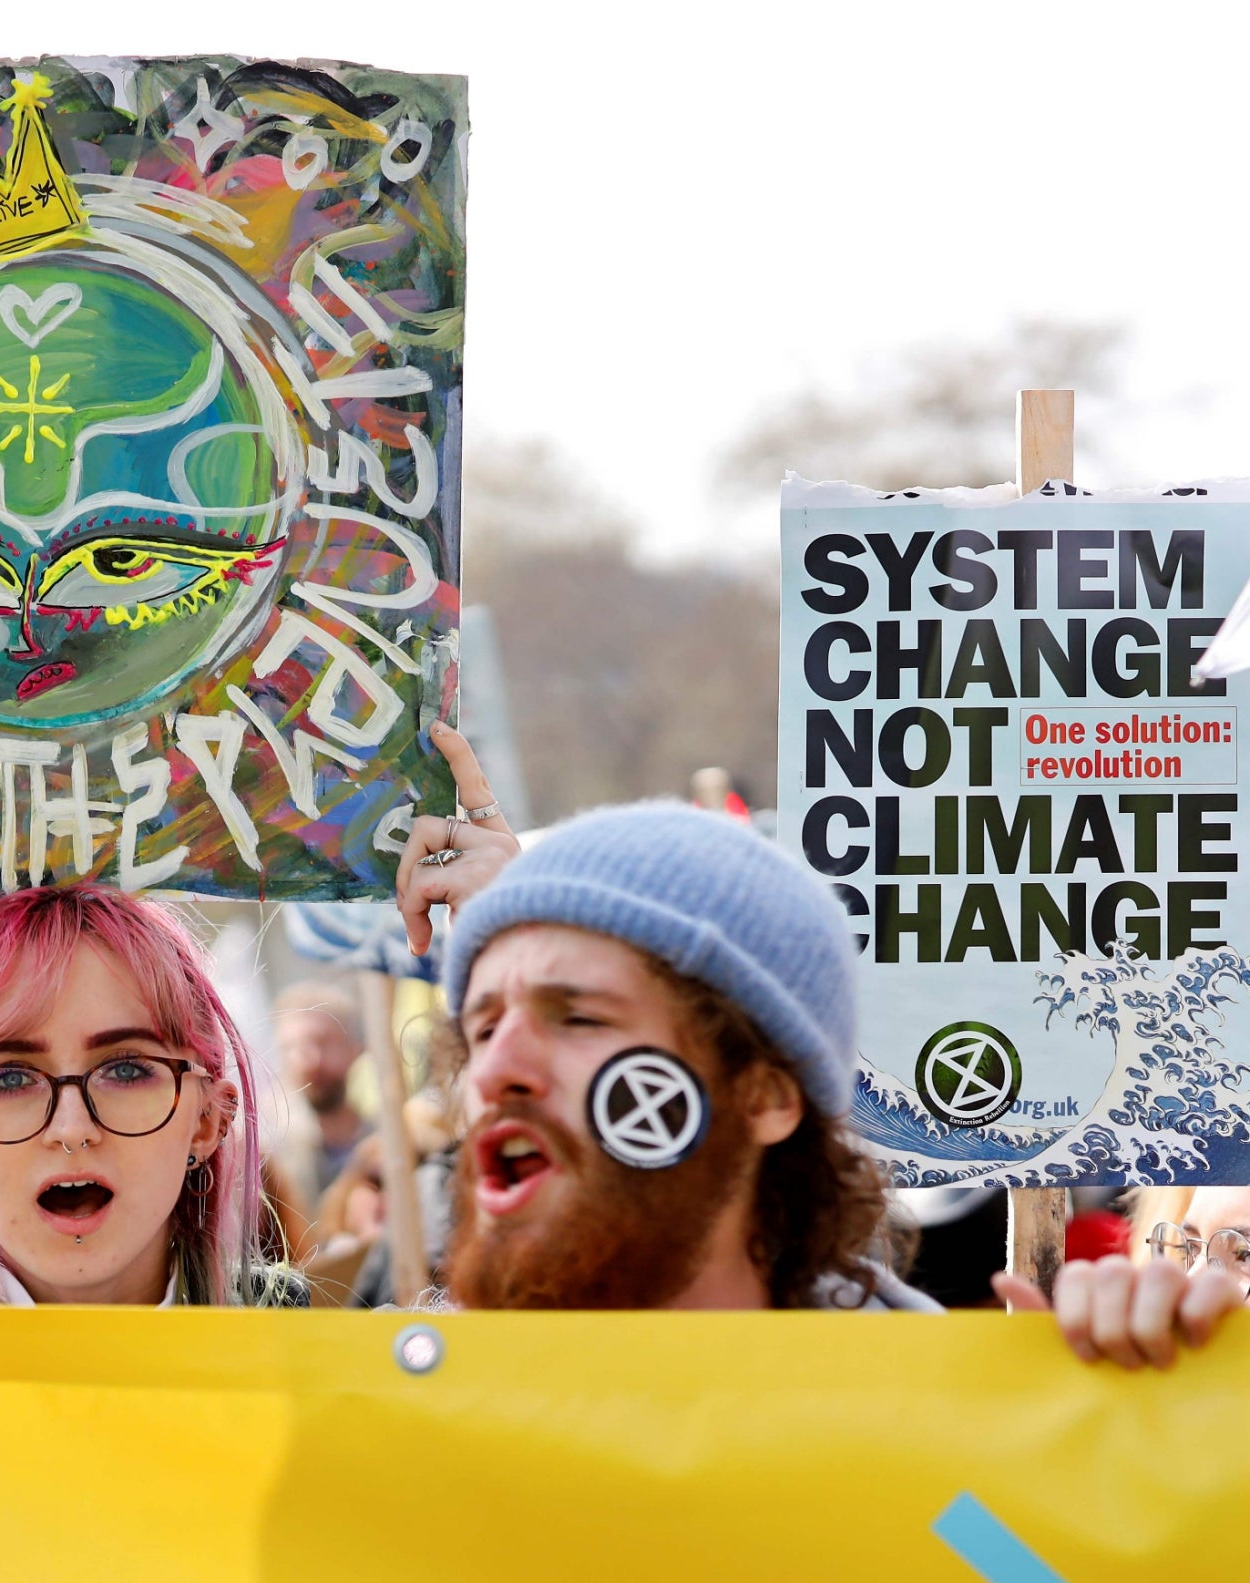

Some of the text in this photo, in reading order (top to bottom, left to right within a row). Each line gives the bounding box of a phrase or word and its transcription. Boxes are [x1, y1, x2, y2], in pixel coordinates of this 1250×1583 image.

[800, 529, 1205, 615] SYSTEM
[803, 617, 1228, 702] CHANGE
[805, 706, 1009, 788] NOT
[1025, 714, 1232, 745] One solution:
[1026, 749, 1182, 778] revolution
[801, 793, 1239, 877] CLIMATE
